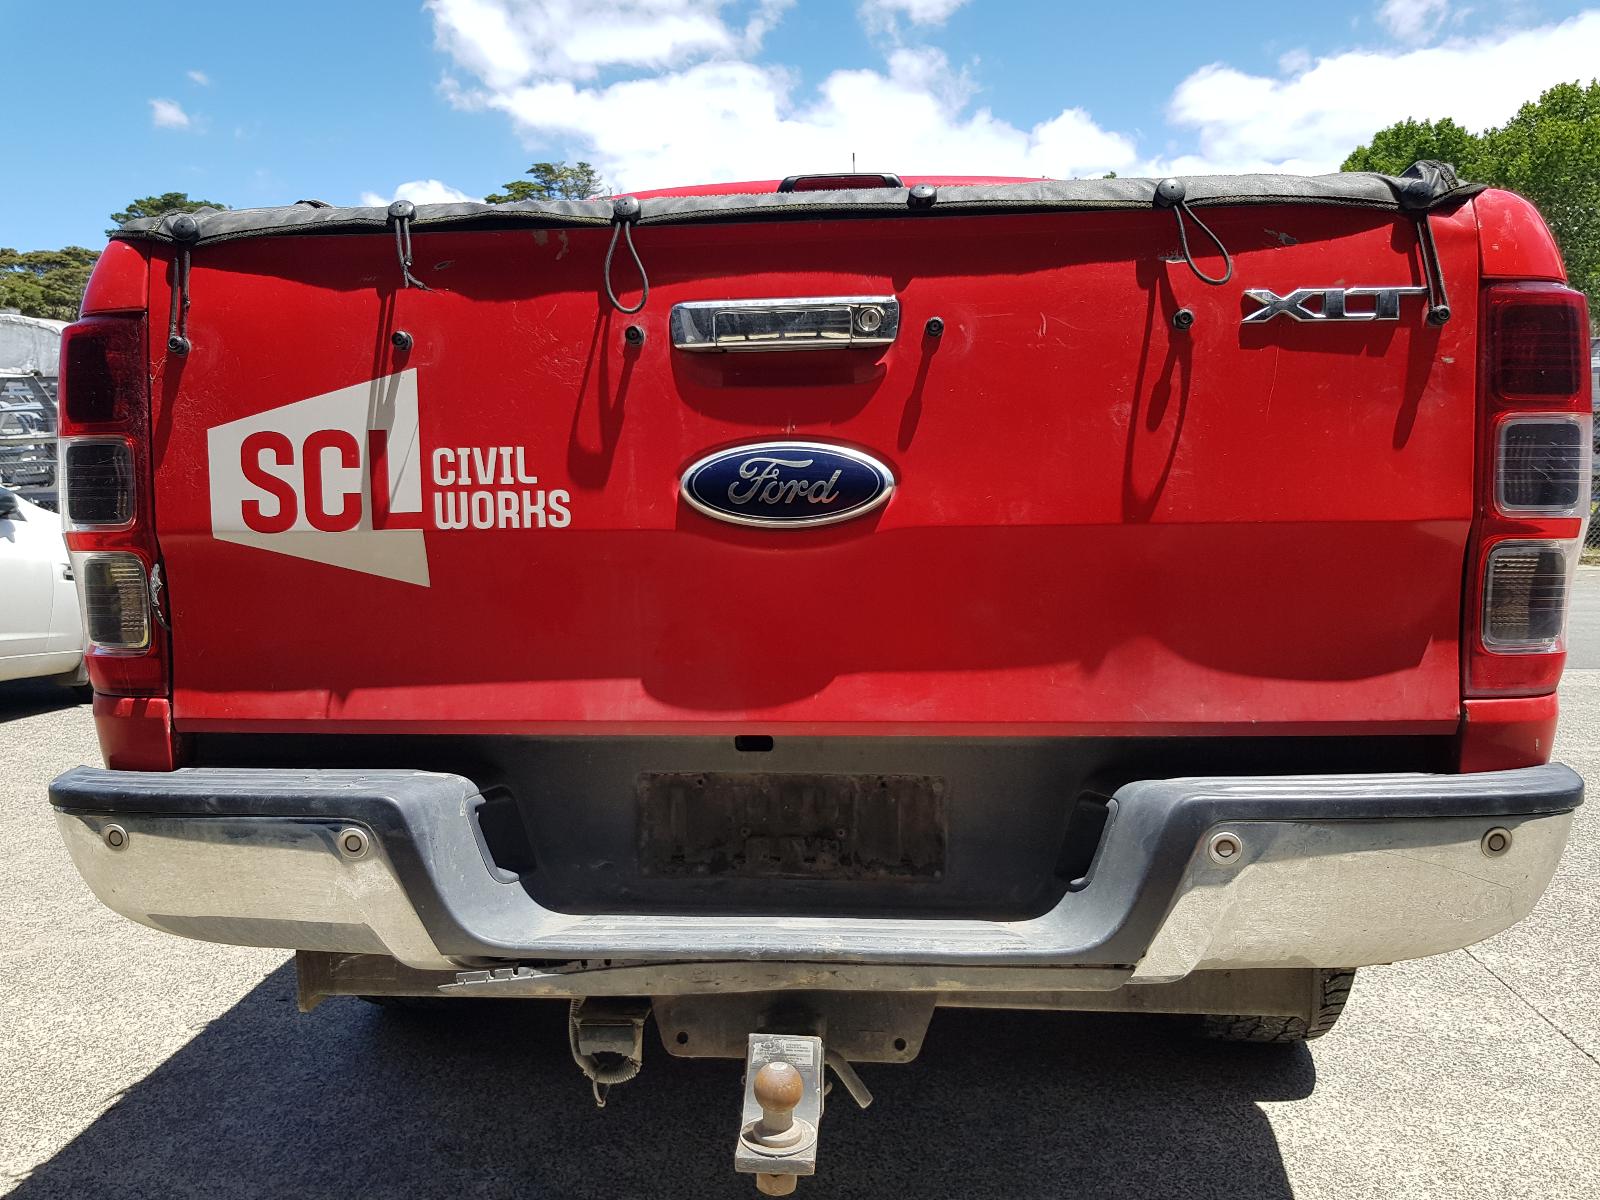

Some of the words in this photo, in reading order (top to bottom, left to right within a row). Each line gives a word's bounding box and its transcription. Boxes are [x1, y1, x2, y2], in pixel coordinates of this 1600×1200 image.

[1241, 287, 1428, 323] XLT
[240, 429, 423, 533] SCL
[433, 446, 538, 486] CIVIL
[727, 457, 842, 505] Ford
[433, 489, 572, 530] WORKS
